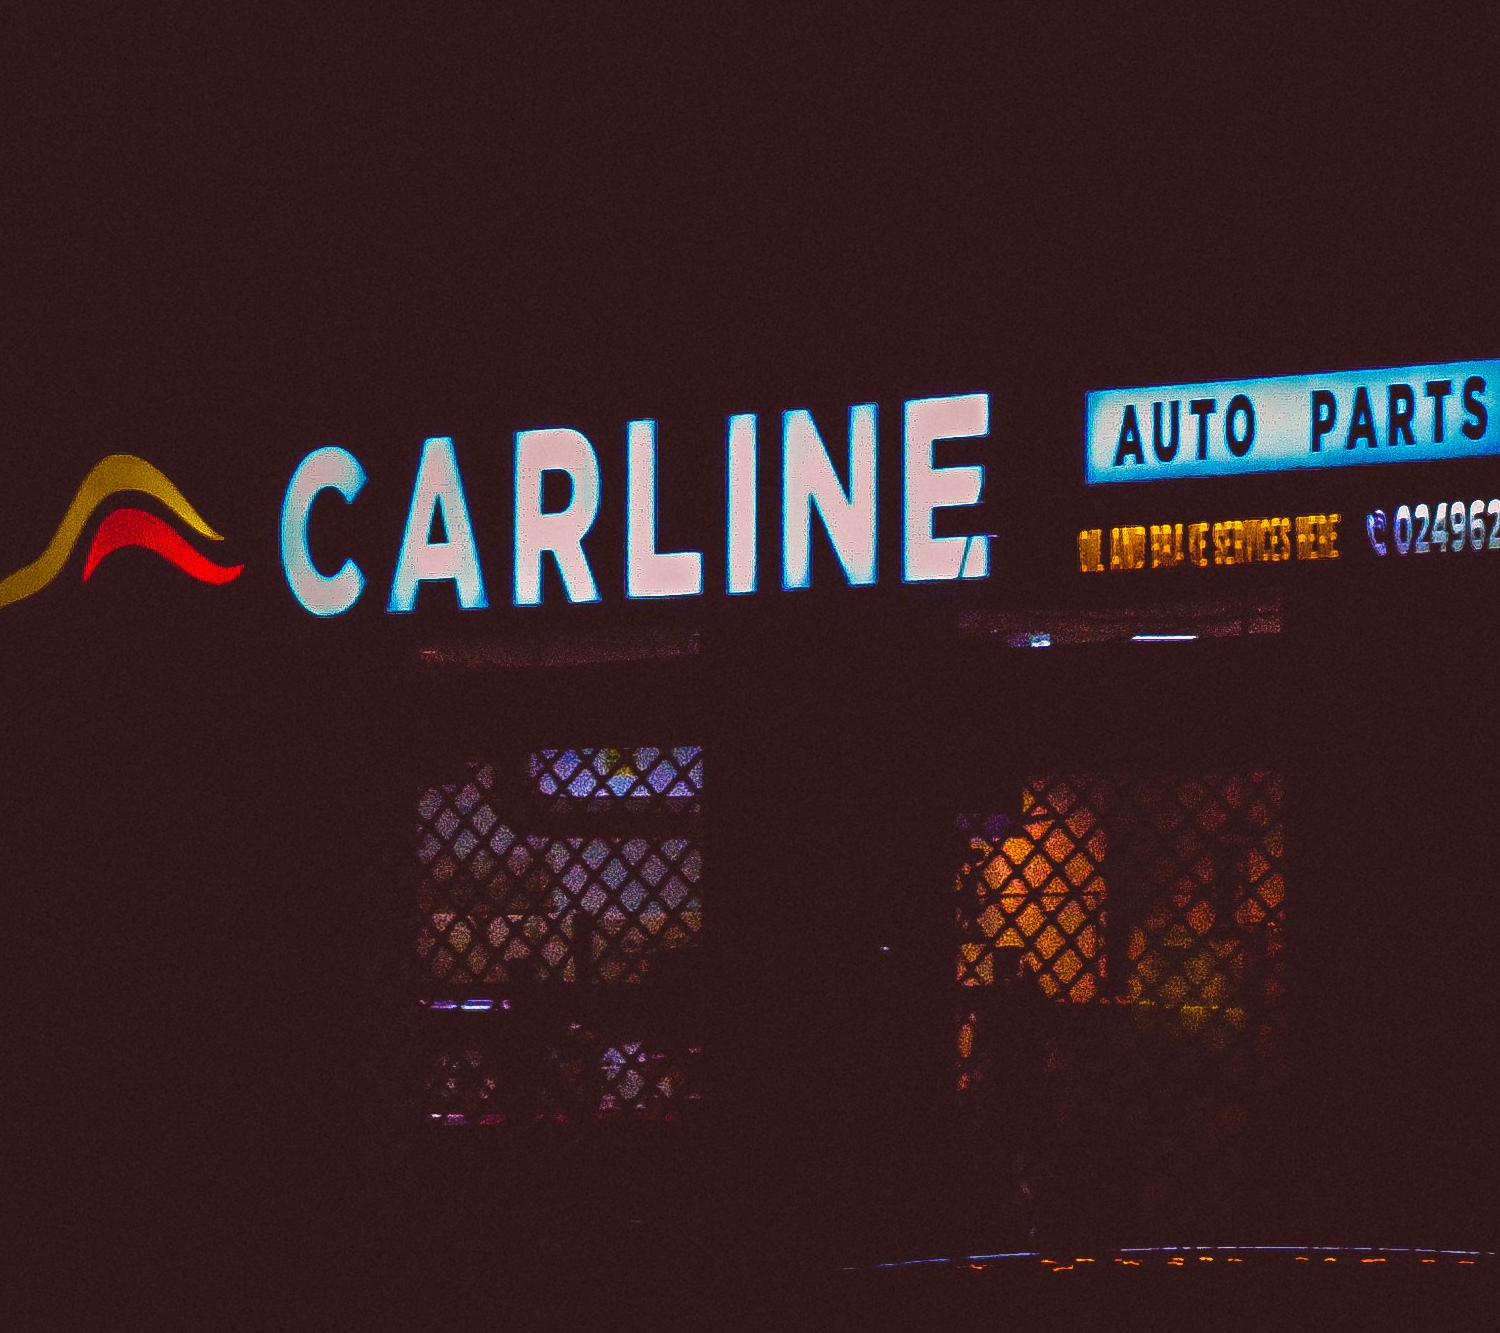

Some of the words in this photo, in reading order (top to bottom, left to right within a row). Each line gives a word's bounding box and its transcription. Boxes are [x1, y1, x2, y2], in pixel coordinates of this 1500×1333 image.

[1112, 393, 1257, 467] AUTO
[1310, 375, 1490, 453] PARTS
[278, 391, 992, 618] CARLINE
